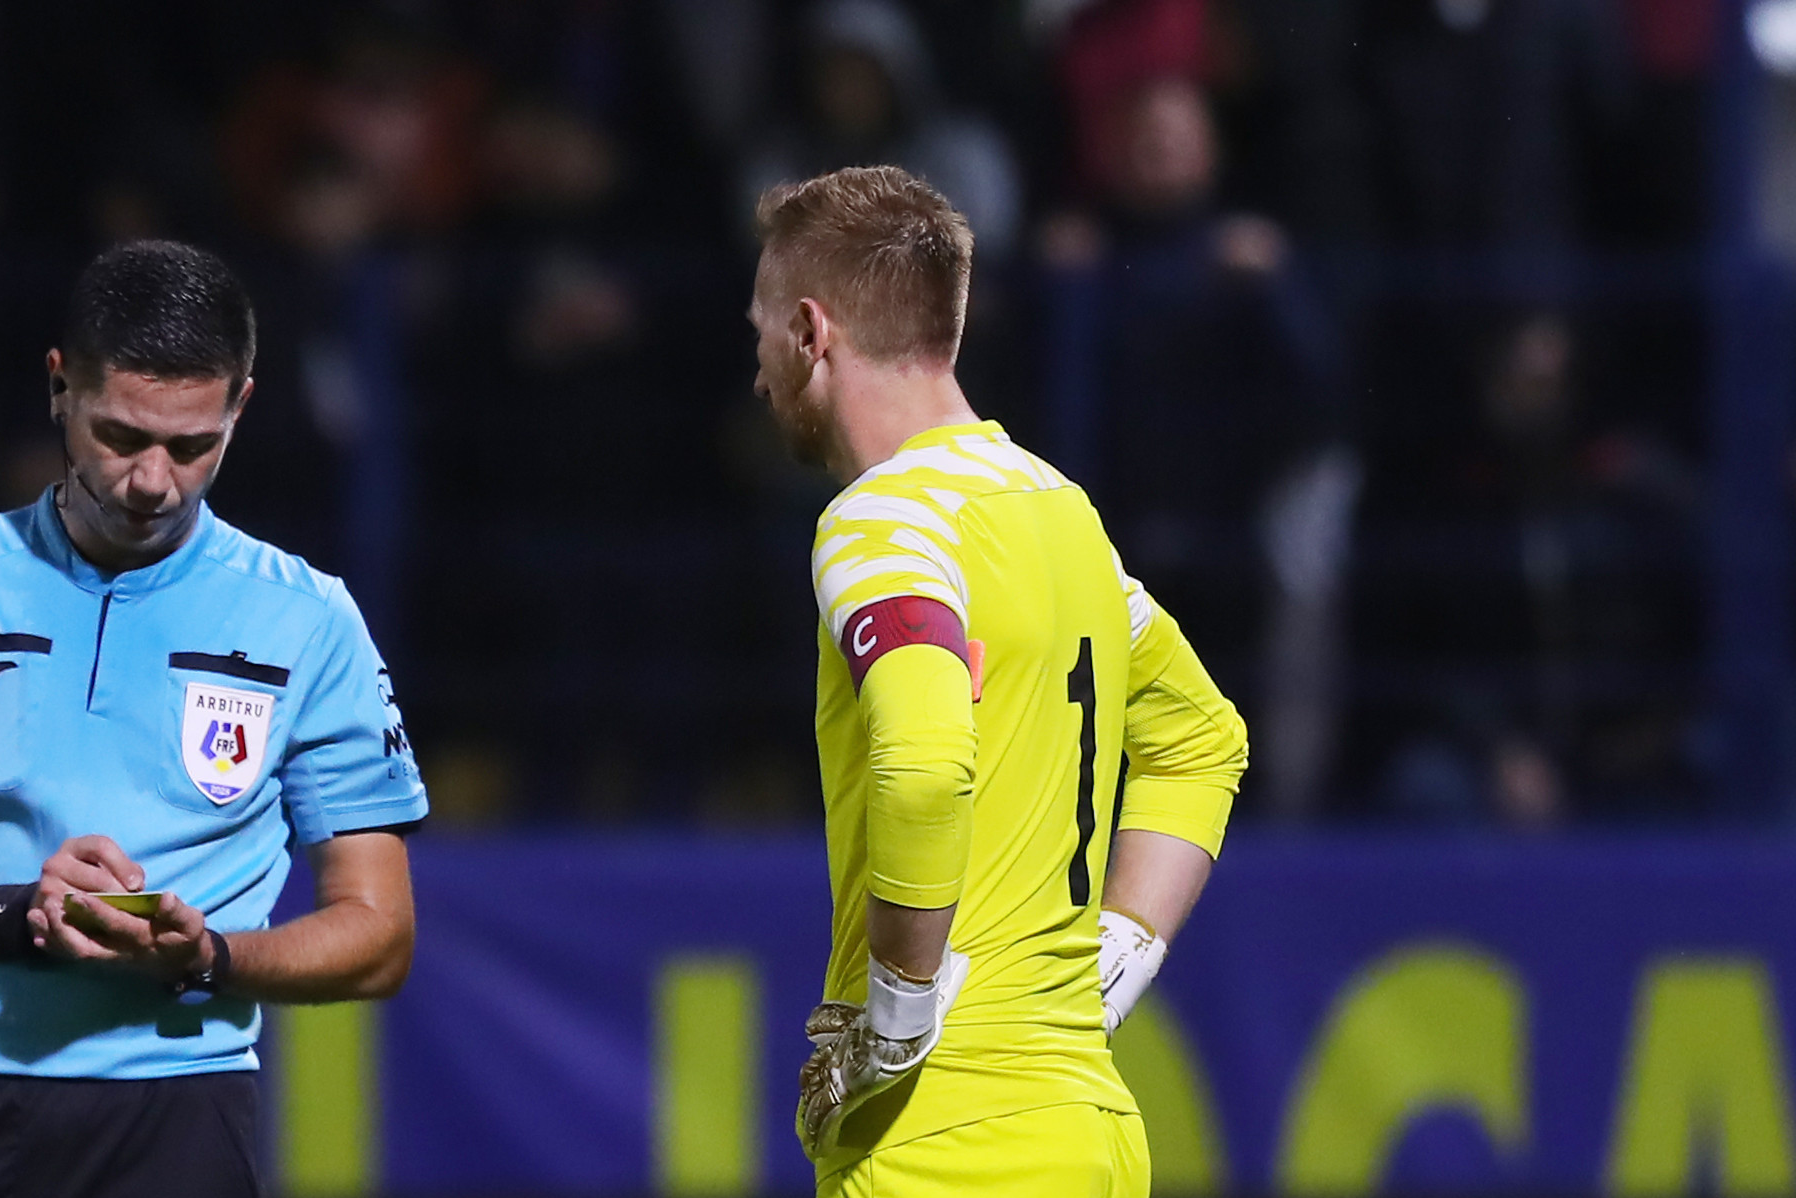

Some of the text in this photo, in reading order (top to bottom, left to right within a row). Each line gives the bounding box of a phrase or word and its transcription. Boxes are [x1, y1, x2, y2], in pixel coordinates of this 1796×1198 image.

[853, 615, 878, 657] C
[196, 695, 264, 718] ARBITRU
[216, 738, 235, 753] FRF
[1067, 637, 1096, 906] 1
